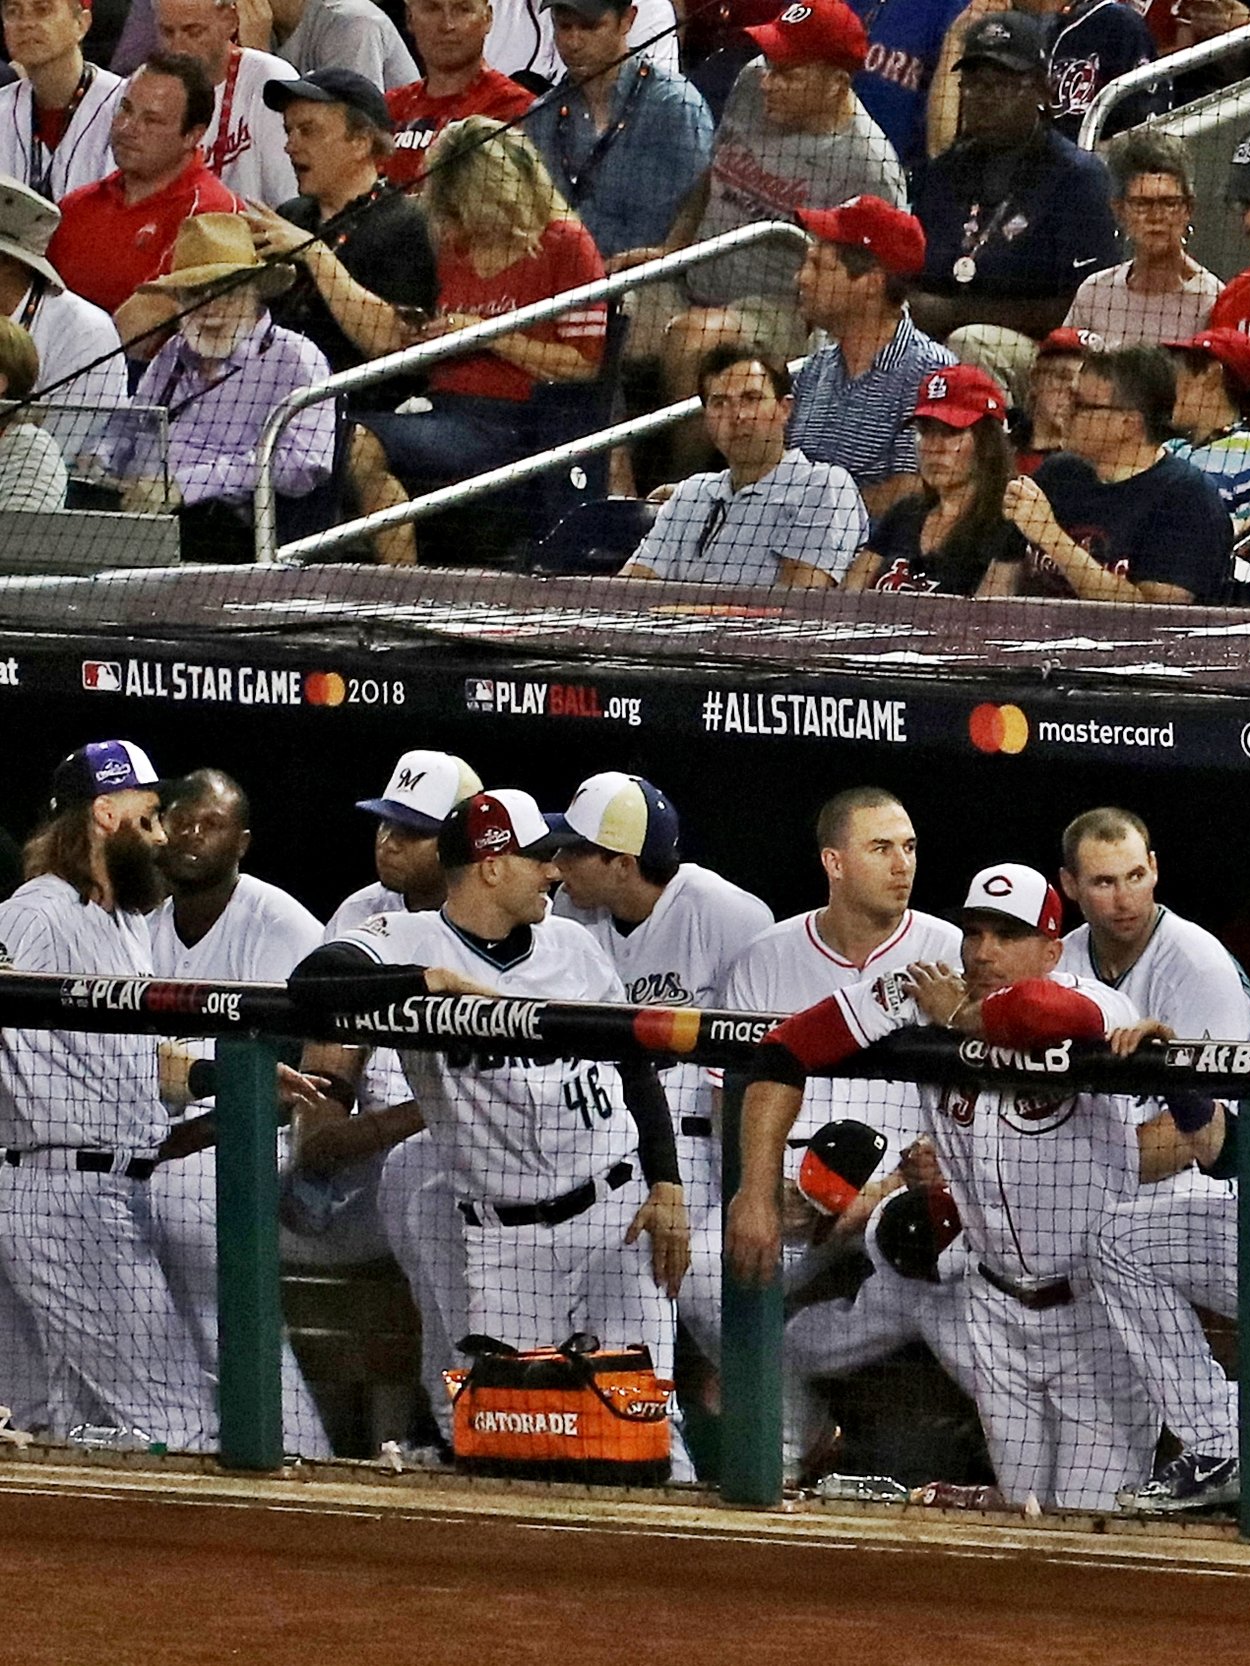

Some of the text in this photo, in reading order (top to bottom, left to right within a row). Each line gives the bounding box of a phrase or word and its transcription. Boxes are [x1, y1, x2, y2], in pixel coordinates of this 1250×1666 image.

[865, 43, 925, 91] ORK
[0, 656, 20, 686] at
[125, 658, 406, 705] ALL STAR GAME 2018
[702, 690, 908, 742] #ALLSTARGAME
[1038, 719, 1175, 748] mastercard
[982, 875, 1014, 897] C
[1195, 1044, 1232, 1073] At
[563, 1064, 613, 1130] 46
[473, 1410, 578, 1436] GATORADE
